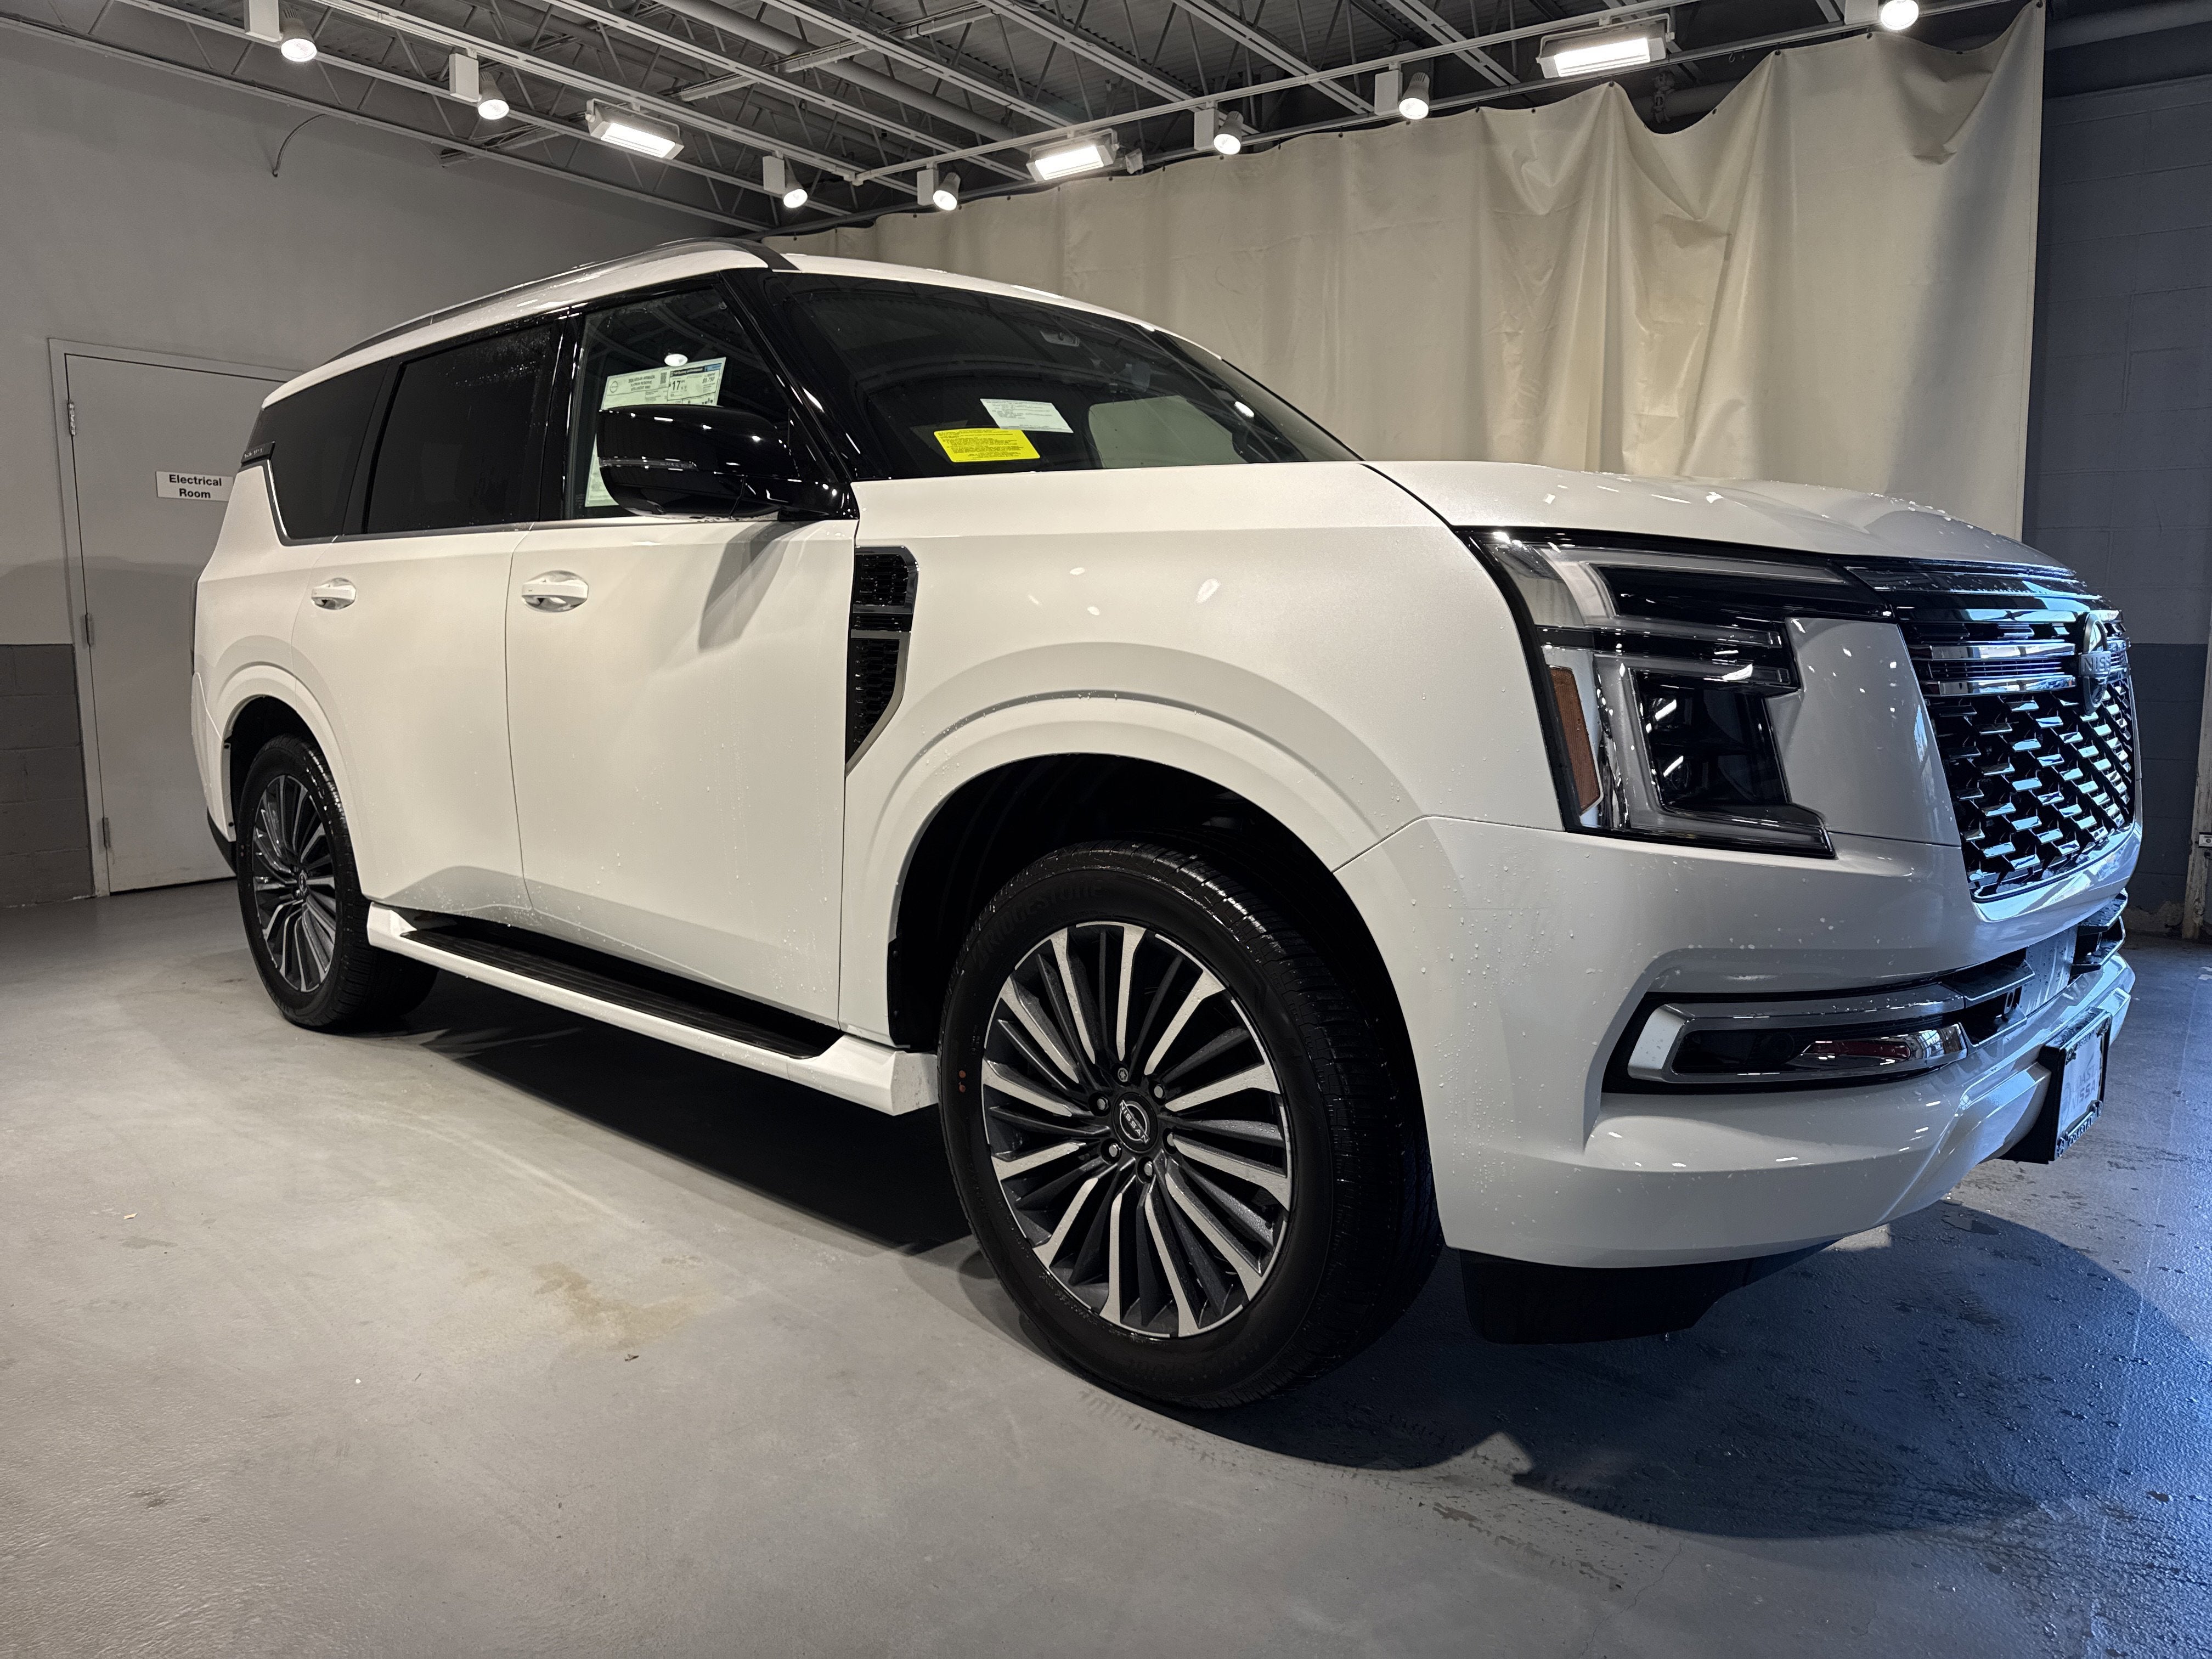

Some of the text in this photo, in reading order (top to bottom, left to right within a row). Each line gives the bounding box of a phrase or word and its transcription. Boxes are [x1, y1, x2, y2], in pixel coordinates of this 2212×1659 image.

[673, 380, 681, 391] 17
[169, 474, 222, 487] Electrical
[179, 488, 211, 499] Room
[2070, 1078, 2098, 1112] NISSA
[1120, 1101, 1149, 1143] NISSAN
